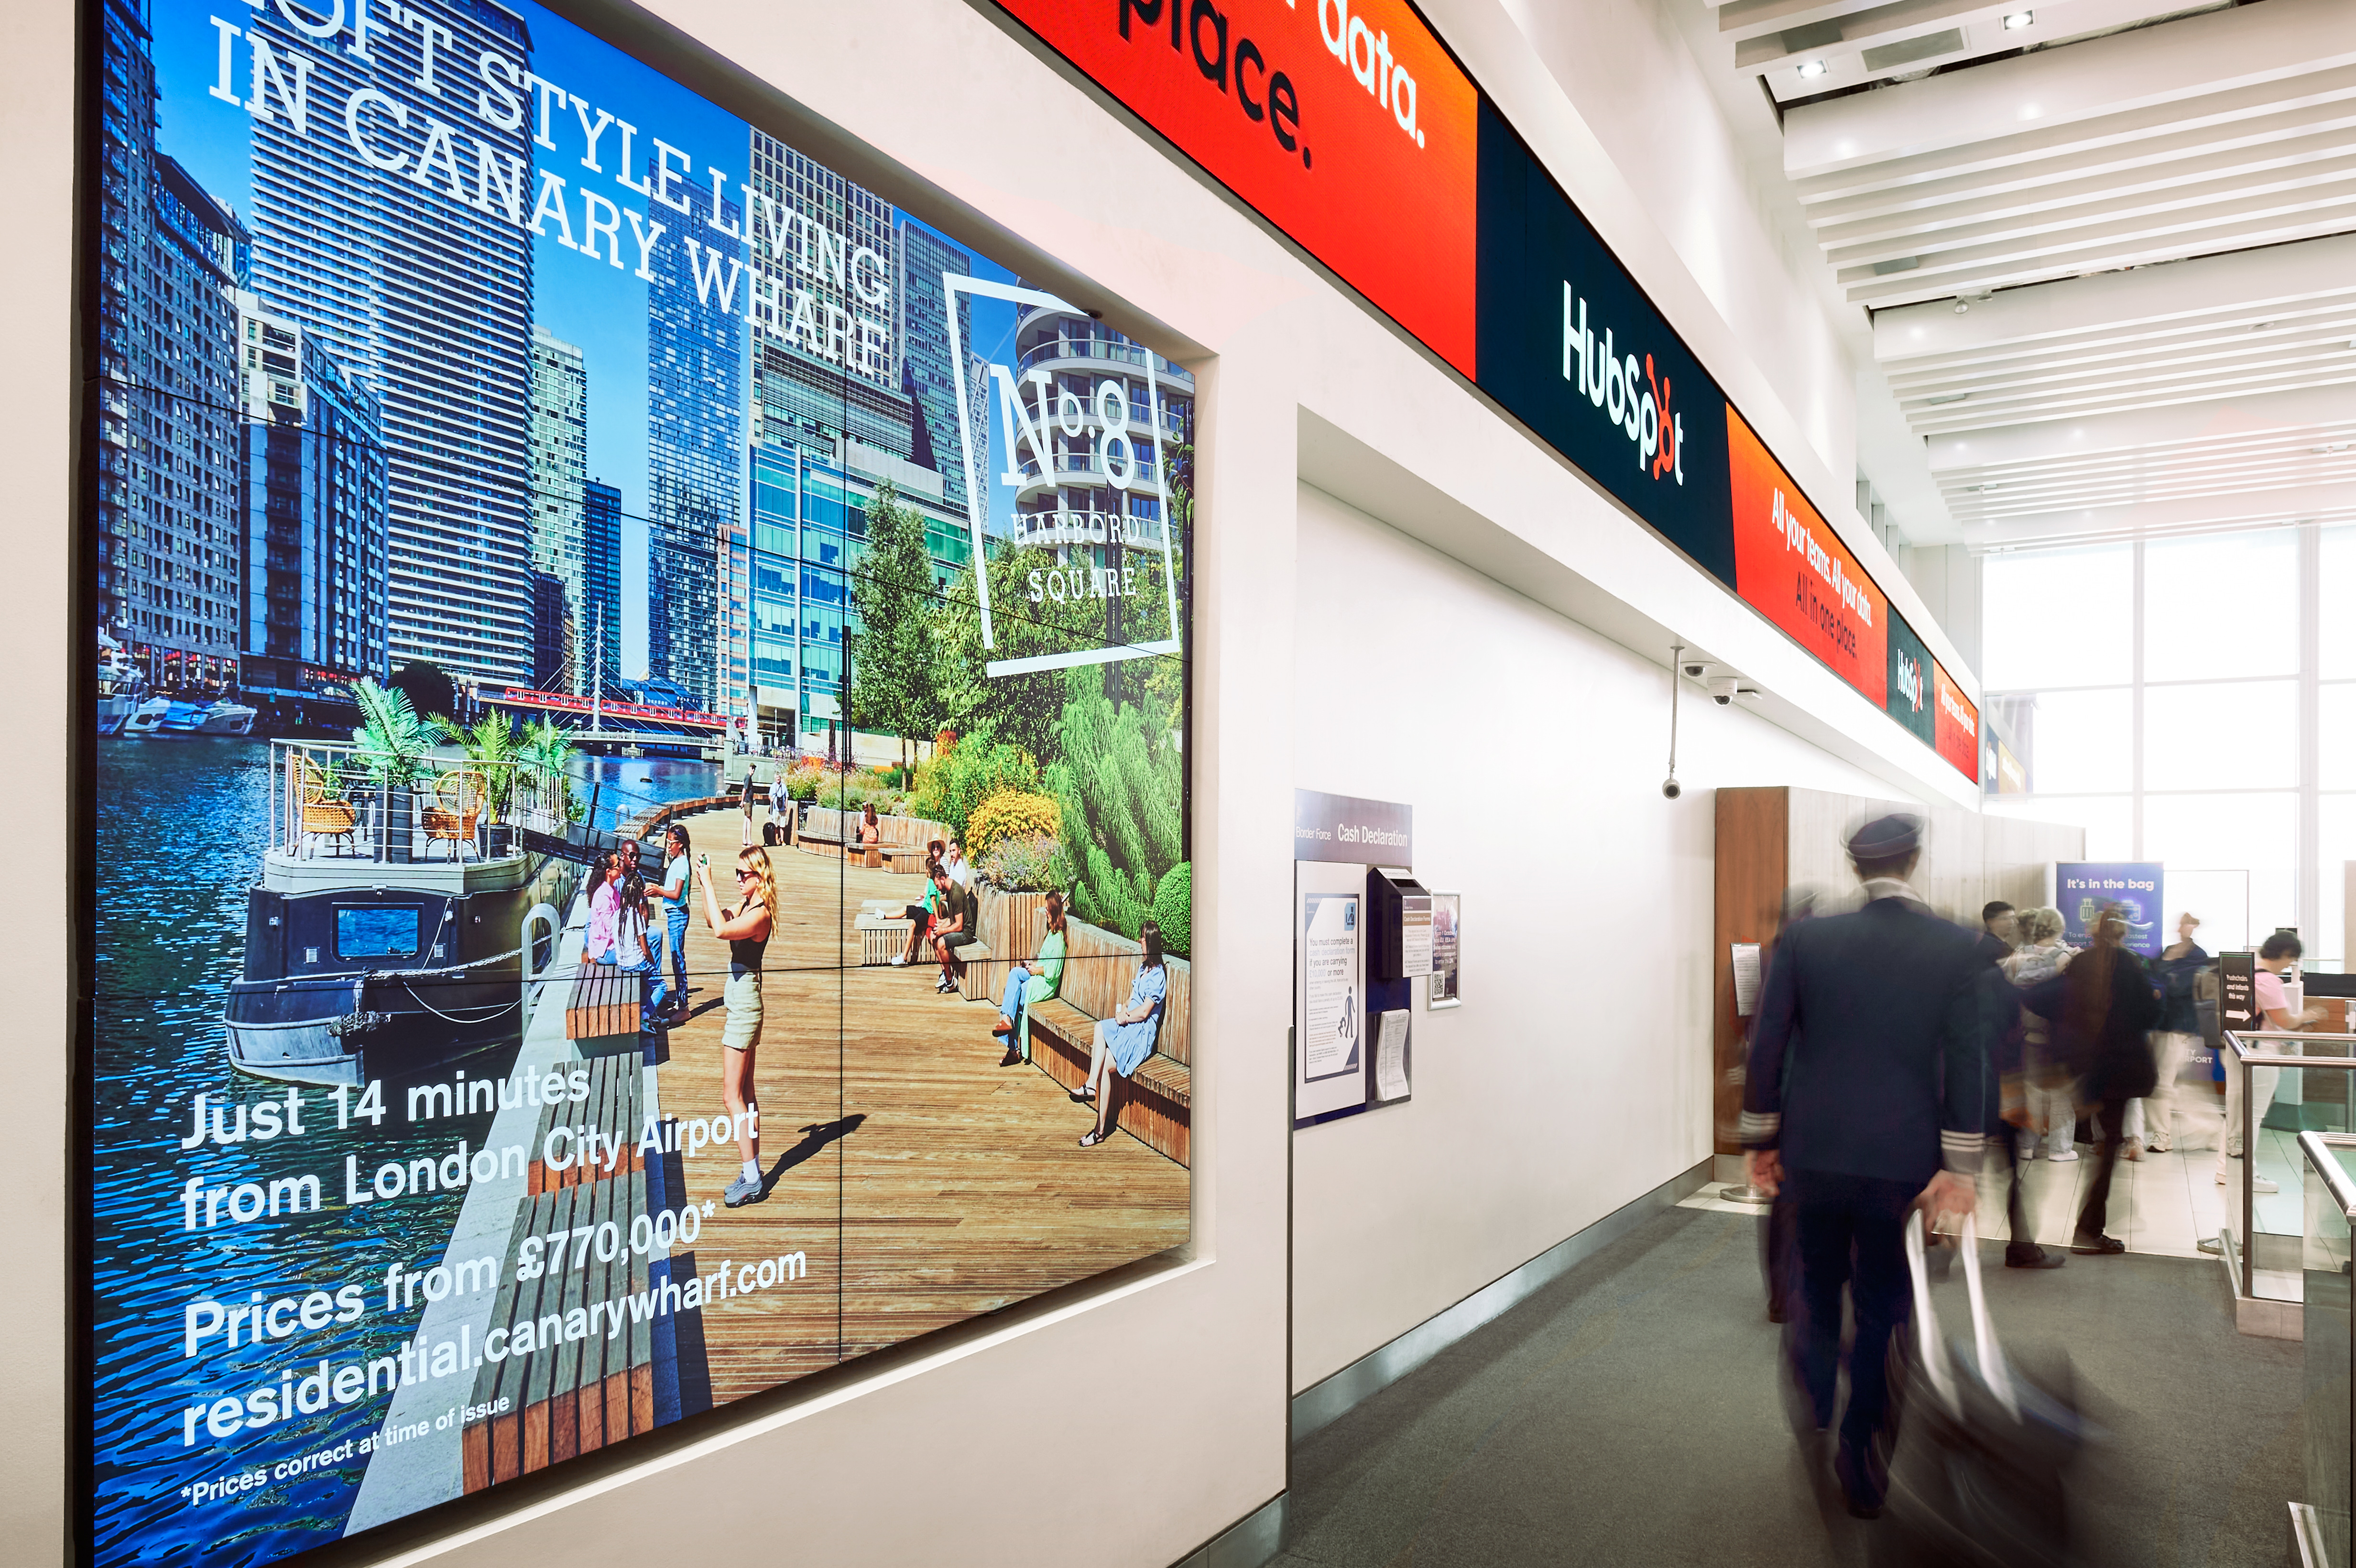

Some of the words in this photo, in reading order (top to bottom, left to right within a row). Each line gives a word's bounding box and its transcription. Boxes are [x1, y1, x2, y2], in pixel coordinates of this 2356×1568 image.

[243, 0, 452, 95] FT
[479, 51, 690, 216] STYLE
[709, 166, 889, 305] LIVING
[209, 15, 315, 134] IN
[345, 88, 666, 283] CANARY
[684, 236, 886, 376] WHARF
[1563, 280, 1683, 486] HubSpot
[1011, 513, 1141, 545] HARBORD
[1772, 487, 1784, 534] All
[1786, 509, 1806, 555] your
[1807, 528, 1831, 585] teams.
[1832, 557, 1841, 595] All
[1842, 574, 1857, 610] your
[1857, 585, 1872, 628] data.
[1029, 567, 1136, 605] SQUARE
[1796, 571, 1808, 615] All
[1810, 579, 1817, 625] in
[1820, 603, 1834, 639] one
[1898, 648, 1923, 713] HubSpot
[1296, 826, 1315, 839] Border
[1316, 828, 1331, 840] Force
[1338, 823, 1360, 843] Cash
[1362, 826, 1408, 847] Declaration
[2067, 879, 2086, 889] It's
[2089, 879, 2100, 889] in
[2103, 879, 2125, 889] the
[2128, 879, 2154, 891] bag
[1309, 948, 1320, 956] cash
[1321, 947, 1345, 956] declaration
[1313, 959, 1321, 968] you
[1330, 957, 1347, 966] carrying
[1331, 937, 1350, 947] complete
[2185, 1056, 2213, 1064] RPORT
[181, 1087, 305, 1149] Just
[327, 1079, 386, 1130] 14
[408, 1067, 590, 1122] minutes
[180, 1174, 320, 1231] from
[346, 1141, 525, 1205] London
[543, 1124, 623, 1172] City
[636, 1102, 759, 1157] Airport
[185, 1283, 365, 1358] Prices
[383, 1256, 497, 1312] from
[184, 1251, 807, 1448] residential.canarywharf.com
[274, 1438, 354, 1480] correct
[359, 1431, 380, 1455] at
[385, 1420, 430, 1447] time
[435, 1407, 456, 1431] of
[460, 1395, 510, 1424] issue
